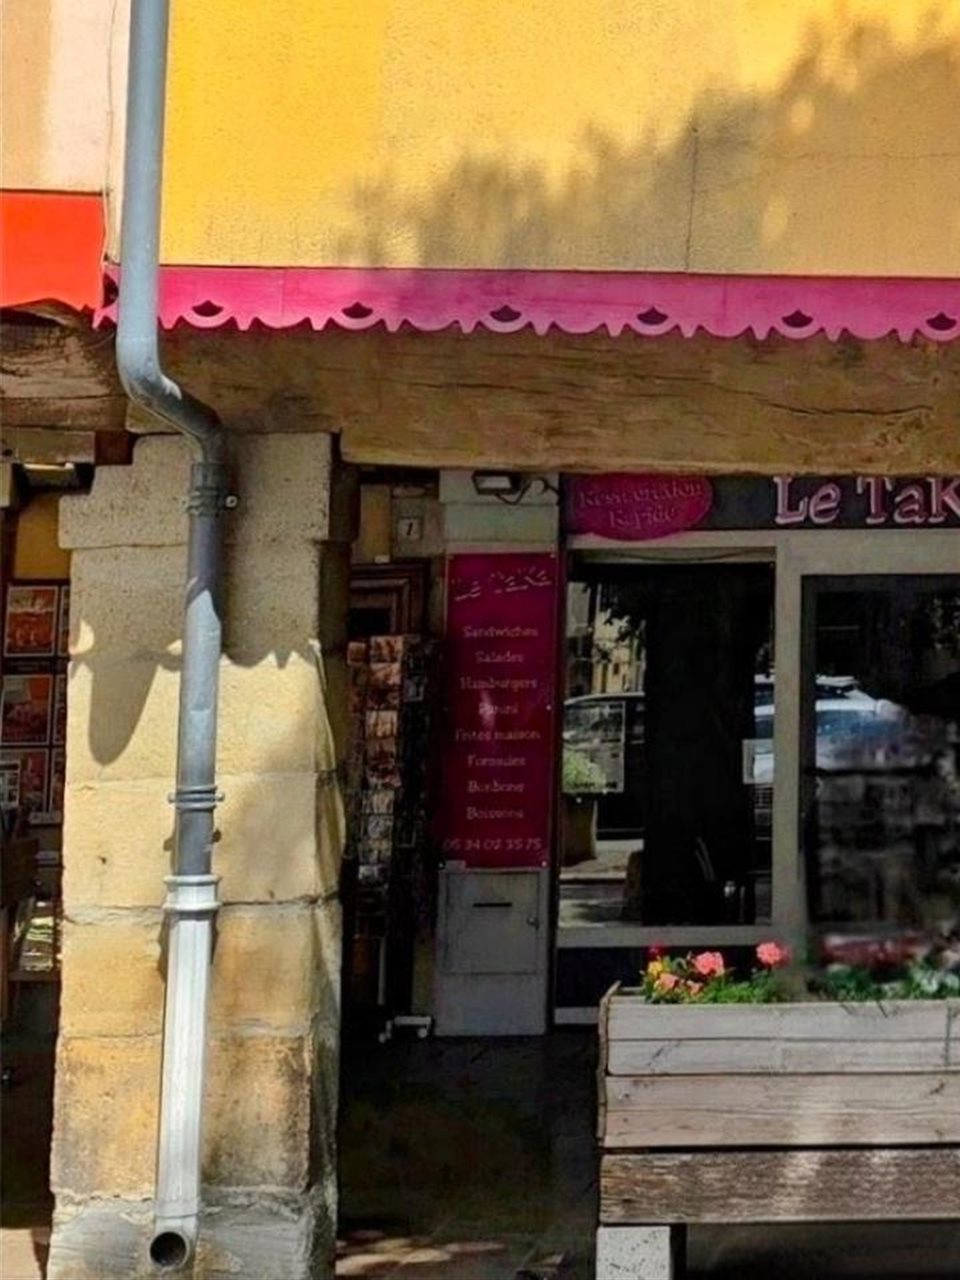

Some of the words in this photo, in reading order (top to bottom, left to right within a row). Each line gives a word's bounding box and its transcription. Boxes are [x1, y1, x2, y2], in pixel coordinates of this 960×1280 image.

[773, 476, 840, 524] Le
[462, 625, 540, 638] Sandwiches
[475, 650, 524, 663] Salades
[460, 676, 538, 692] Hamburgers
